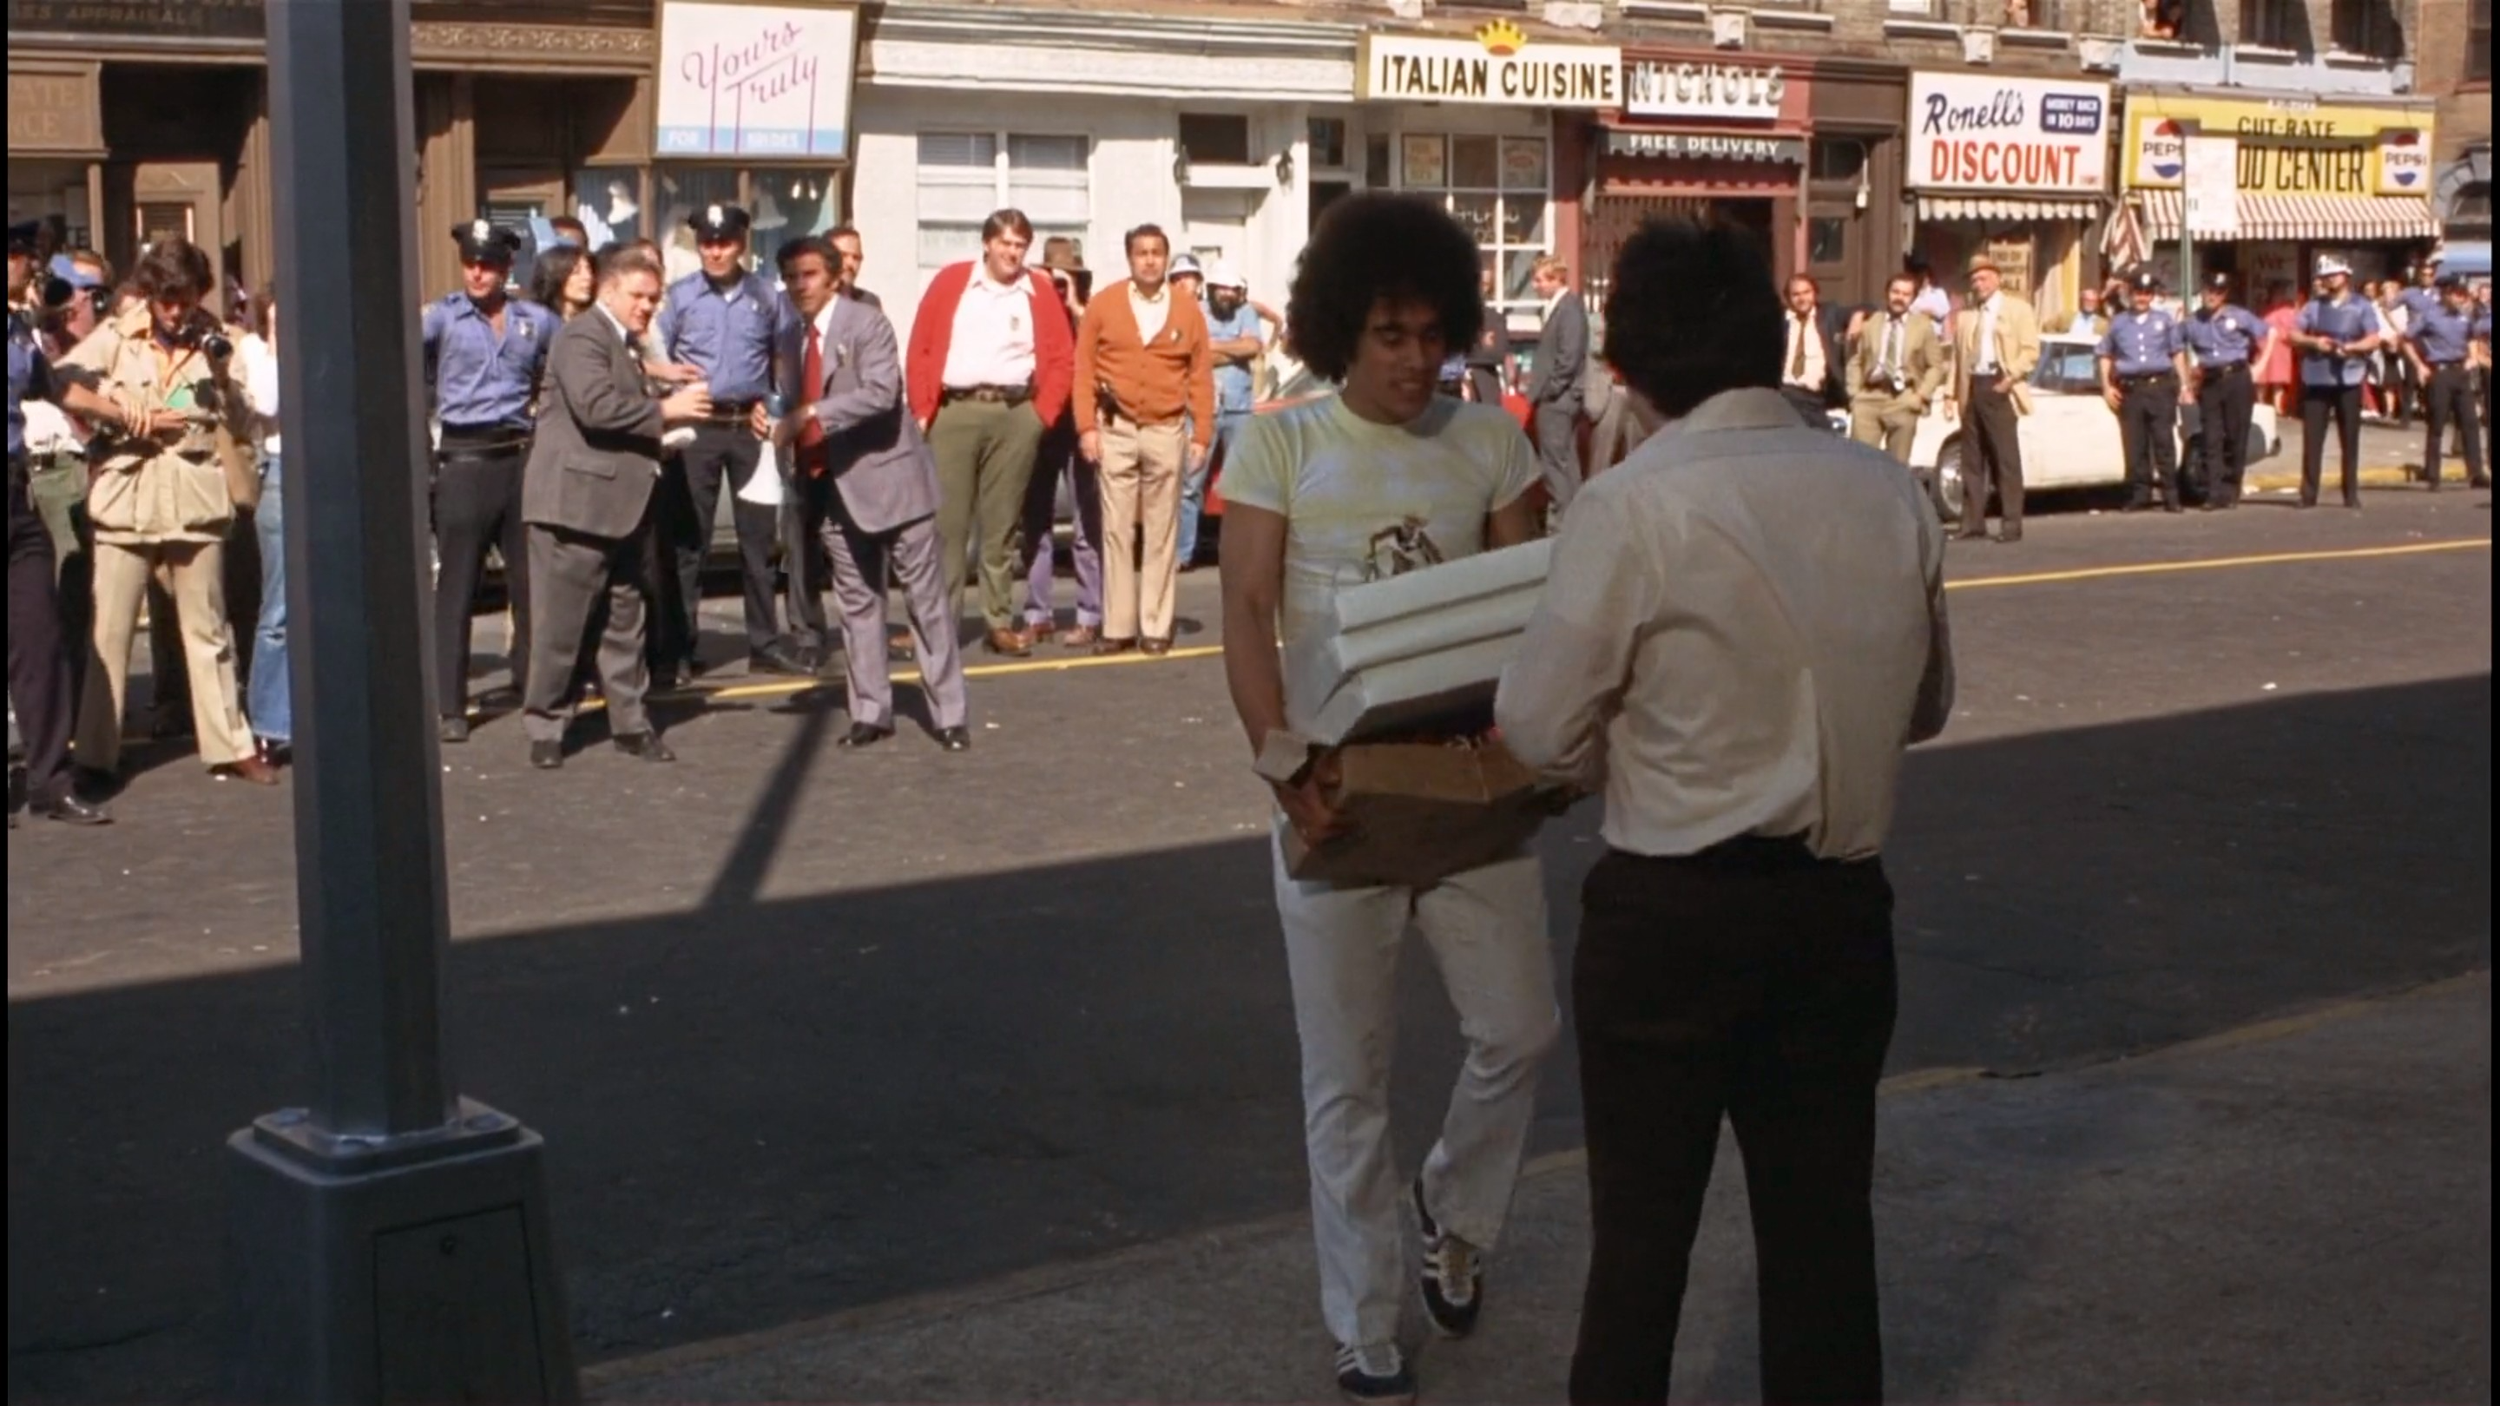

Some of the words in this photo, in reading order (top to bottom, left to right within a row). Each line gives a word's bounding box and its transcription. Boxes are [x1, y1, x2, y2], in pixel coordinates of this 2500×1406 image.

[1382, 54, 1487, 96] ITALIAN
[1501, 61, 1613, 99] CUISINE
[1631, 60, 1785, 105] NICHOLS
[1922, 88, 2024, 135] Ronell's
[2058, 112, 2074, 129] 10
[2237, 116, 2337, 139] CUT-RATE
[1629, 135, 1677, 149] FREE
[1687, 136, 1781, 156] DELIVERY
[1931, 139, 2081, 185] DISCOUNT
[2143, 141, 2183, 157] PEP
[2385, 151, 2428, 166] PEPSI
[2276, 145, 2364, 193] CENTER
